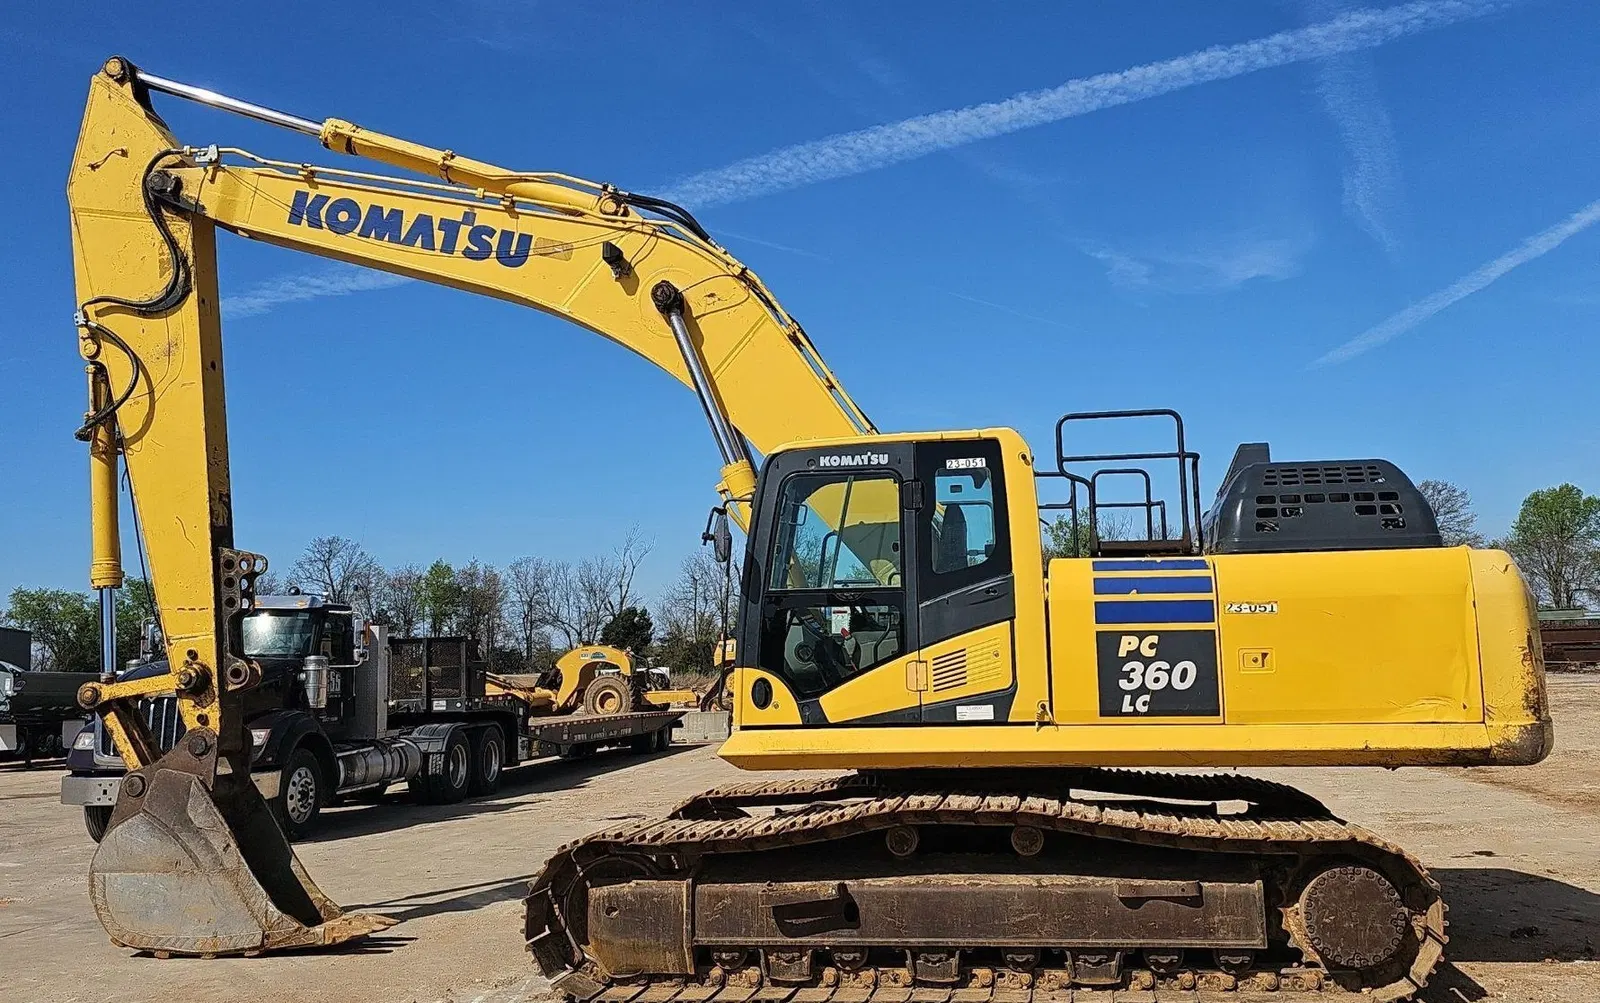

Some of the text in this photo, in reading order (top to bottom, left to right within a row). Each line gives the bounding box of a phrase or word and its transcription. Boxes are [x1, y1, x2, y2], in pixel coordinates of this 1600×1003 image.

[287, 190, 533, 268] KOMATSU
[819, 452, 889, 467] KOMATSU
[947, 458, 985, 469] 23-051
[1118, 635, 1158, 657] PC
[1118, 660, 1197, 691] 360
[1121, 694, 1151, 713] LC
